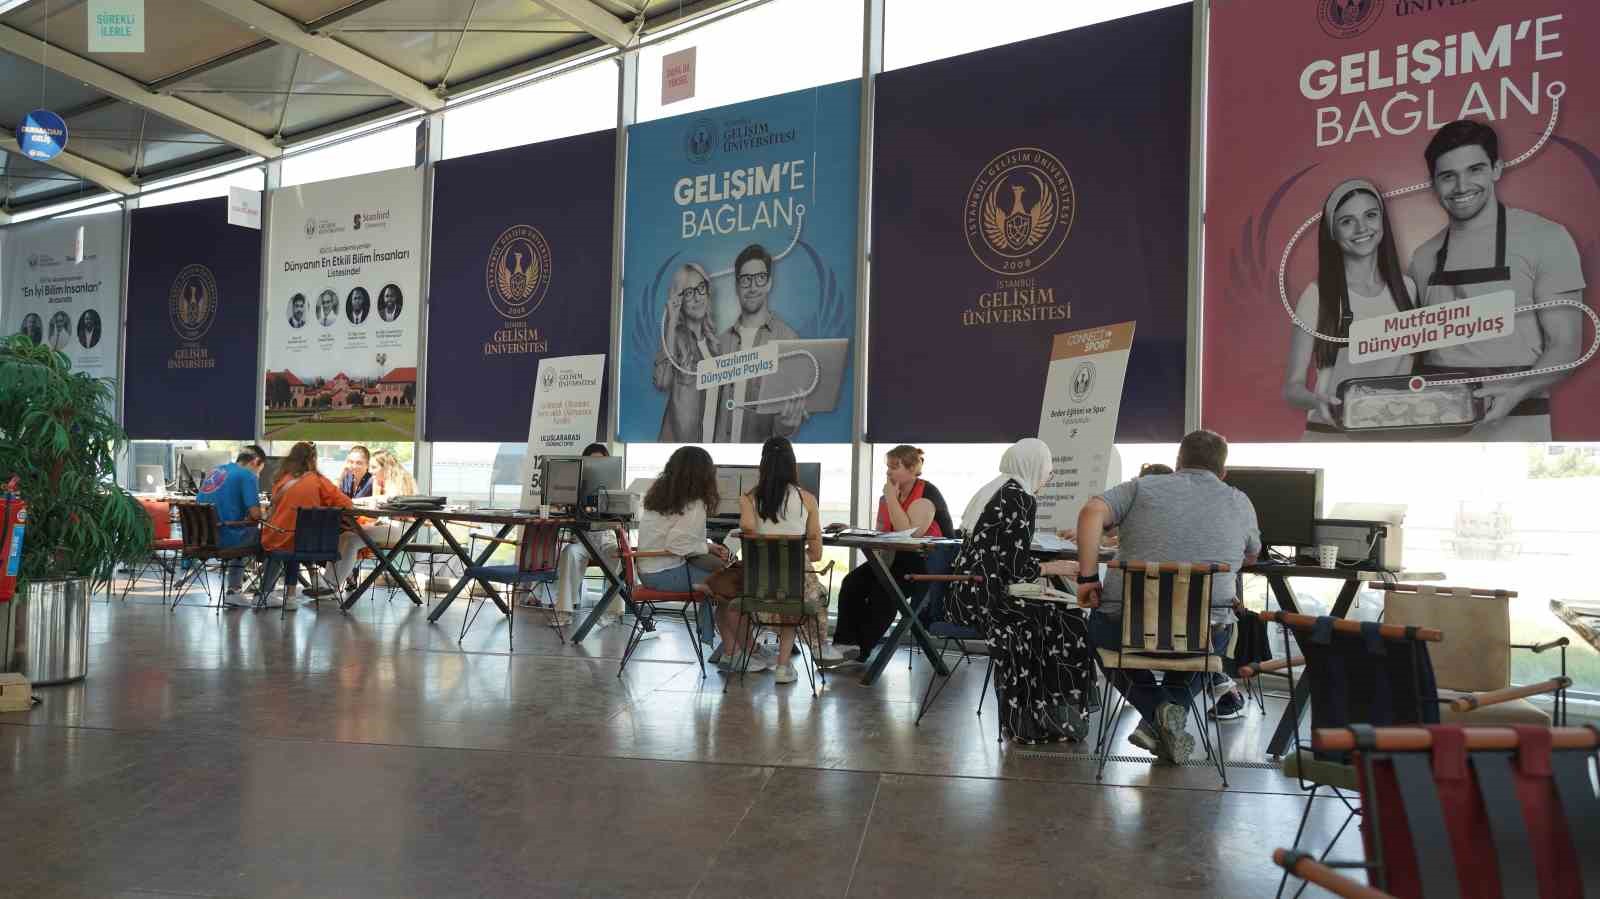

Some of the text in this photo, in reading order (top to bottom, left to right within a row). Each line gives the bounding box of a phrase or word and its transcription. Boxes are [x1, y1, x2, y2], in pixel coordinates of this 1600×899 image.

[1300, 14, 1563, 100] GELİŞİM'E
[1316, 72, 1539, 147] BAĞLAN
[673, 160, 805, 206] GELİŞİM'E
[681, 197, 793, 239] BAĞLAN
[284, 249, 410, 273] Dünyanın En Etkili Bilim İnsanları
[979, 286, 1056, 310] GELİŞİM
[962, 302, 1073, 327] ÜNİVERSİTESİ
[1384, 305, 1470, 333] Mutfağını
[484, 340, 548, 355] ÜNİVERSİTESİ
[494, 328, 538, 343] GELİŞİM
[1358, 316, 1505, 356] Dünyayla Paylaş
[701, 359, 773, 383] Dünyayla Paylaş
[716, 352, 758, 368] Yazılımını
